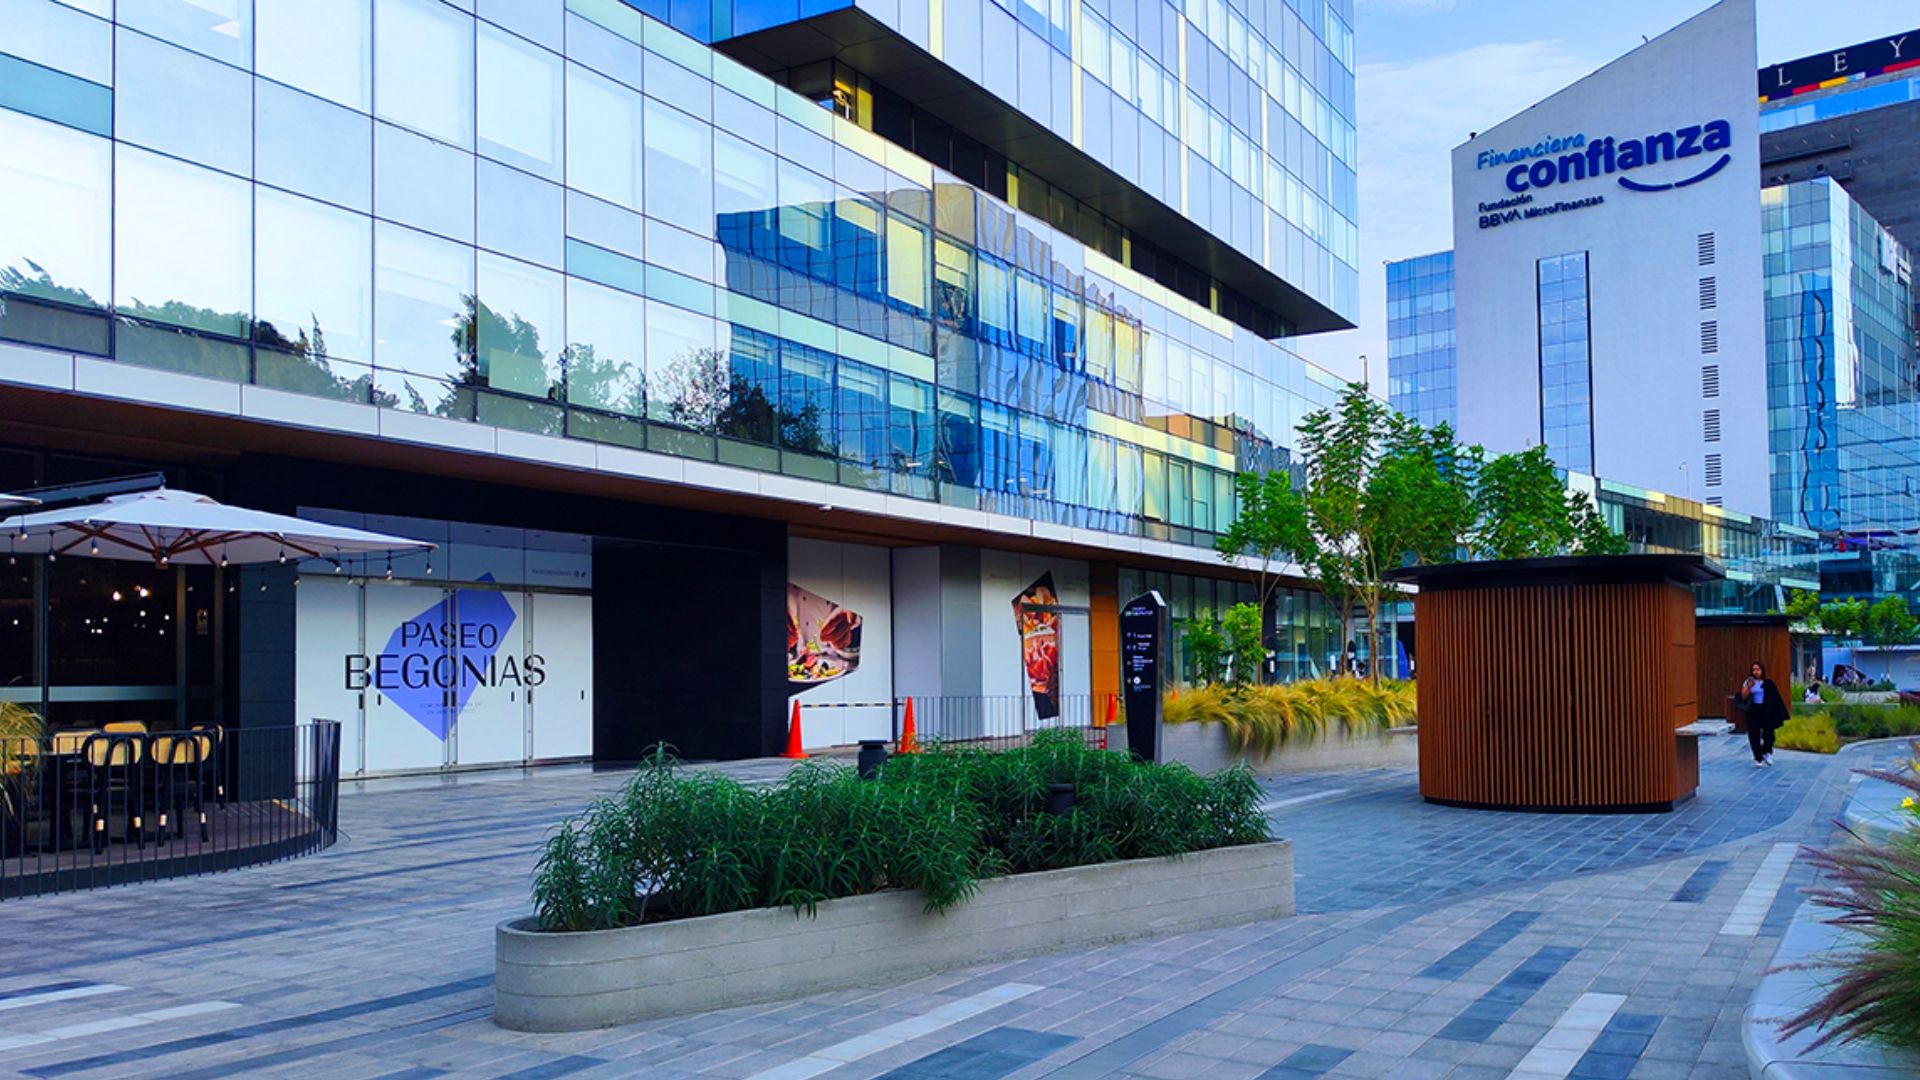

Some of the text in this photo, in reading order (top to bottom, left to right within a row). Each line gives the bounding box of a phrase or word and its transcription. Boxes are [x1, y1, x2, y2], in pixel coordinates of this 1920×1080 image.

[1477, 133, 1586, 170] Financiera
[1506, 119, 1731, 193] confianza
[1478, 194, 1534, 213] Fundación
[1479, 195, 1605, 230] BBVA MicroFinanzas
[401, 621, 499, 649] PASEO
[344, 653, 547, 691] BEGONIAS
